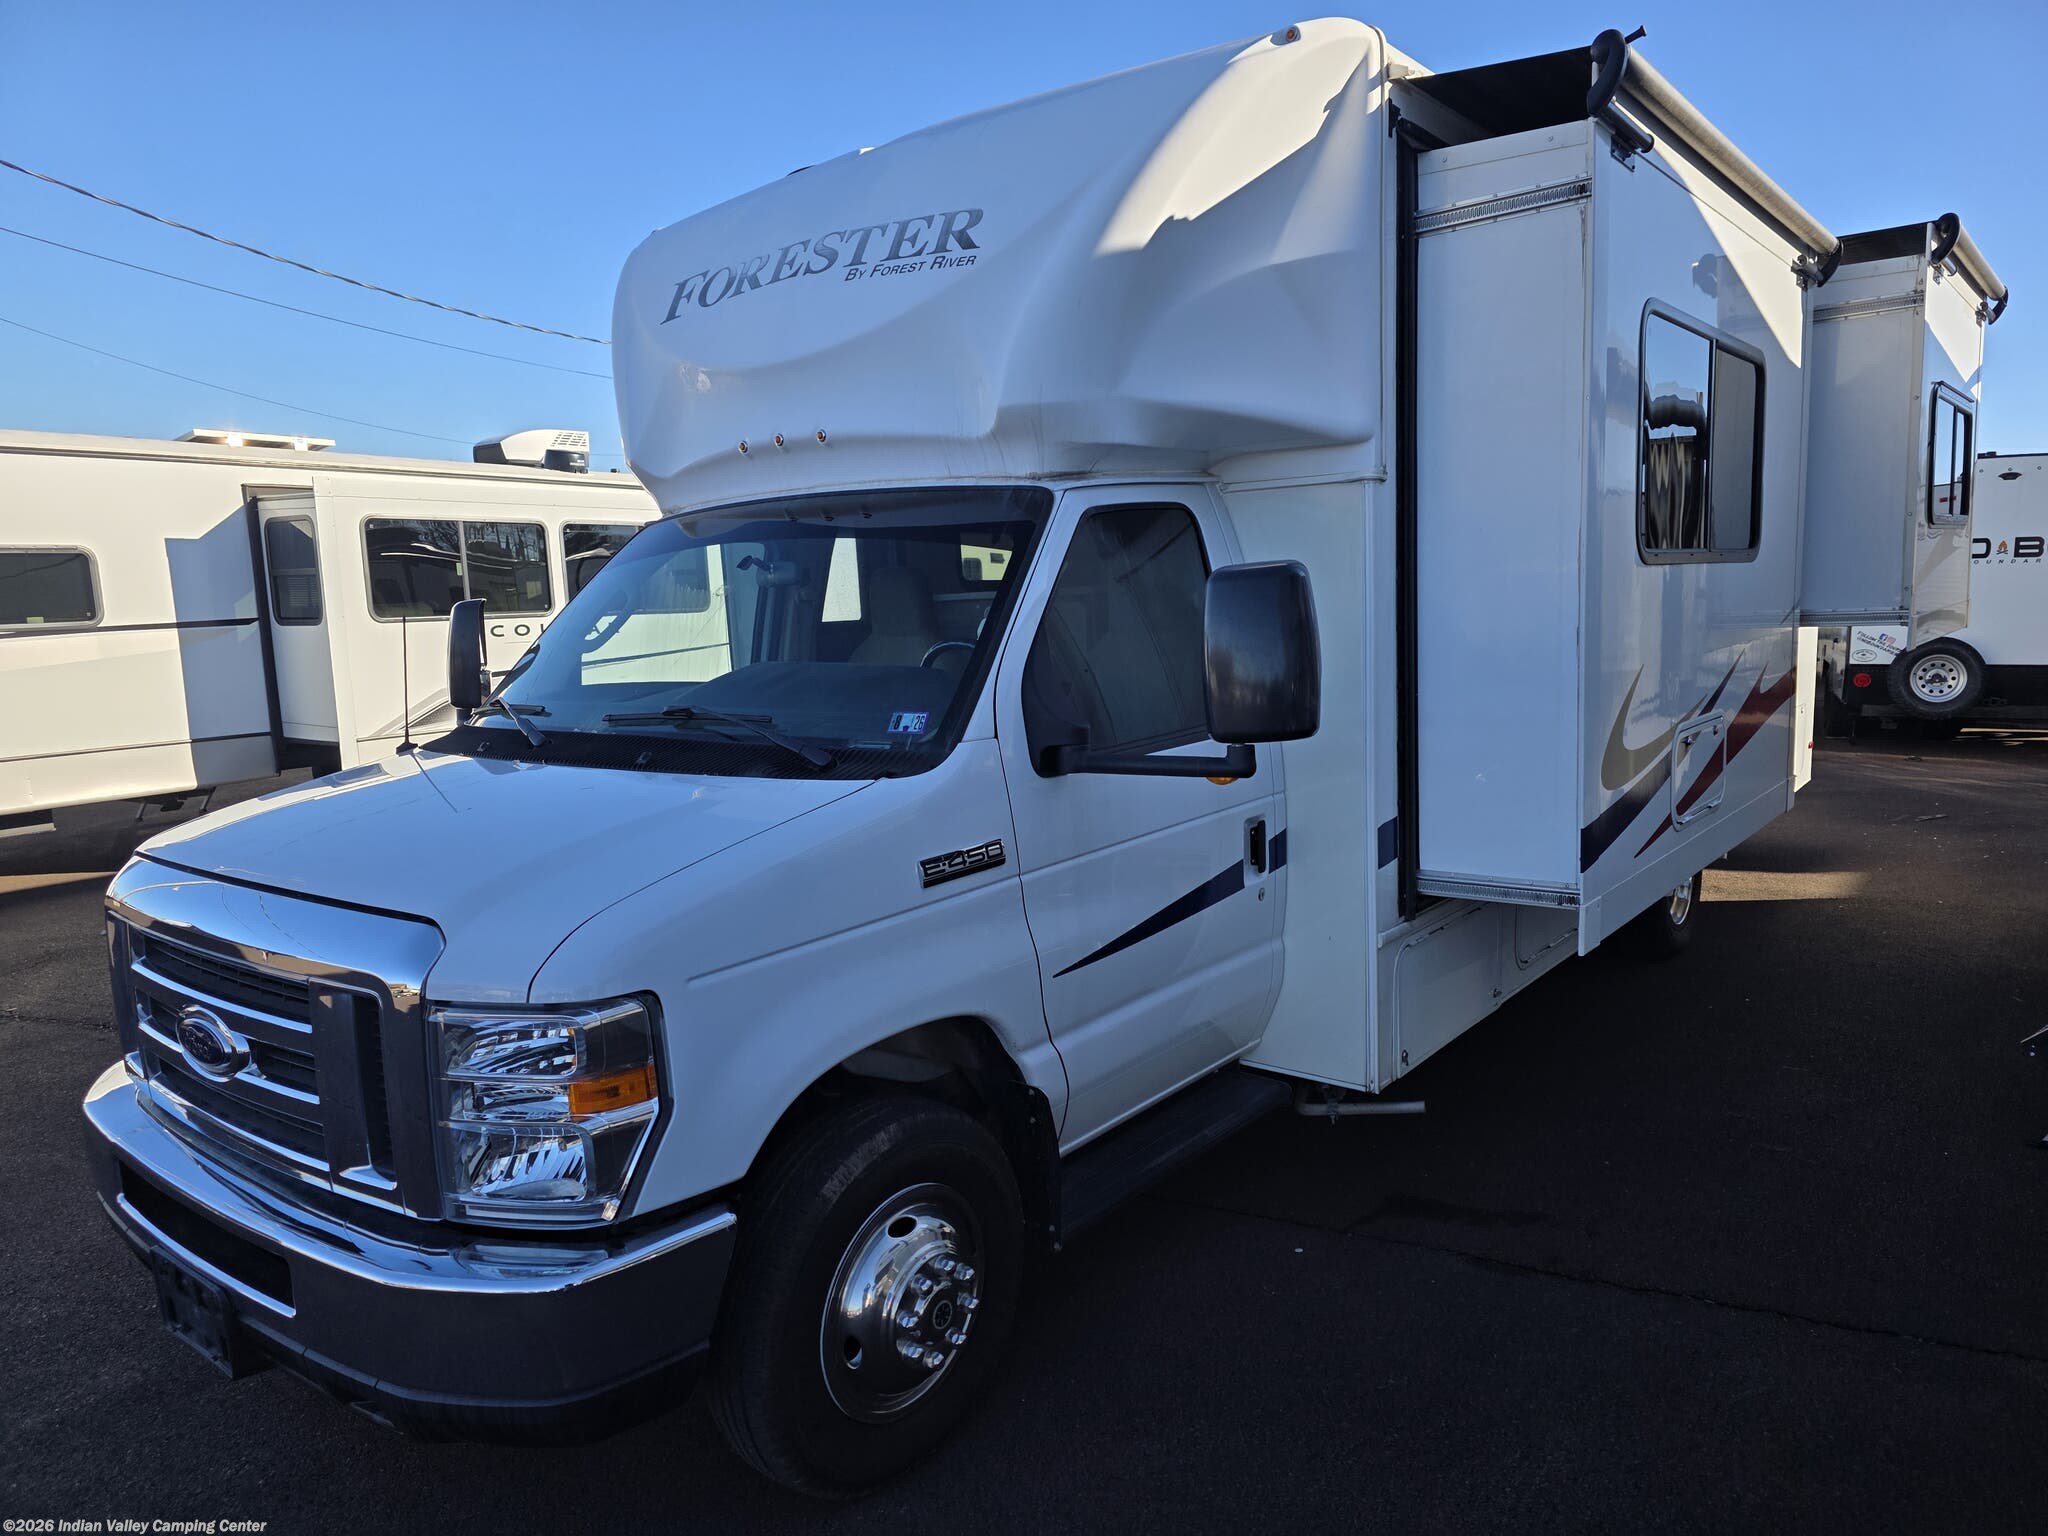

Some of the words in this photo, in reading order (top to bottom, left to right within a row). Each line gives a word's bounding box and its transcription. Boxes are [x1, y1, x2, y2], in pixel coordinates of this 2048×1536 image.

[659, 208, 984, 325] FORESTER
[870, 261, 926, 278] FOREST
[930, 255, 977, 270] RIVER
[2013, 536, 2045, 558] B
